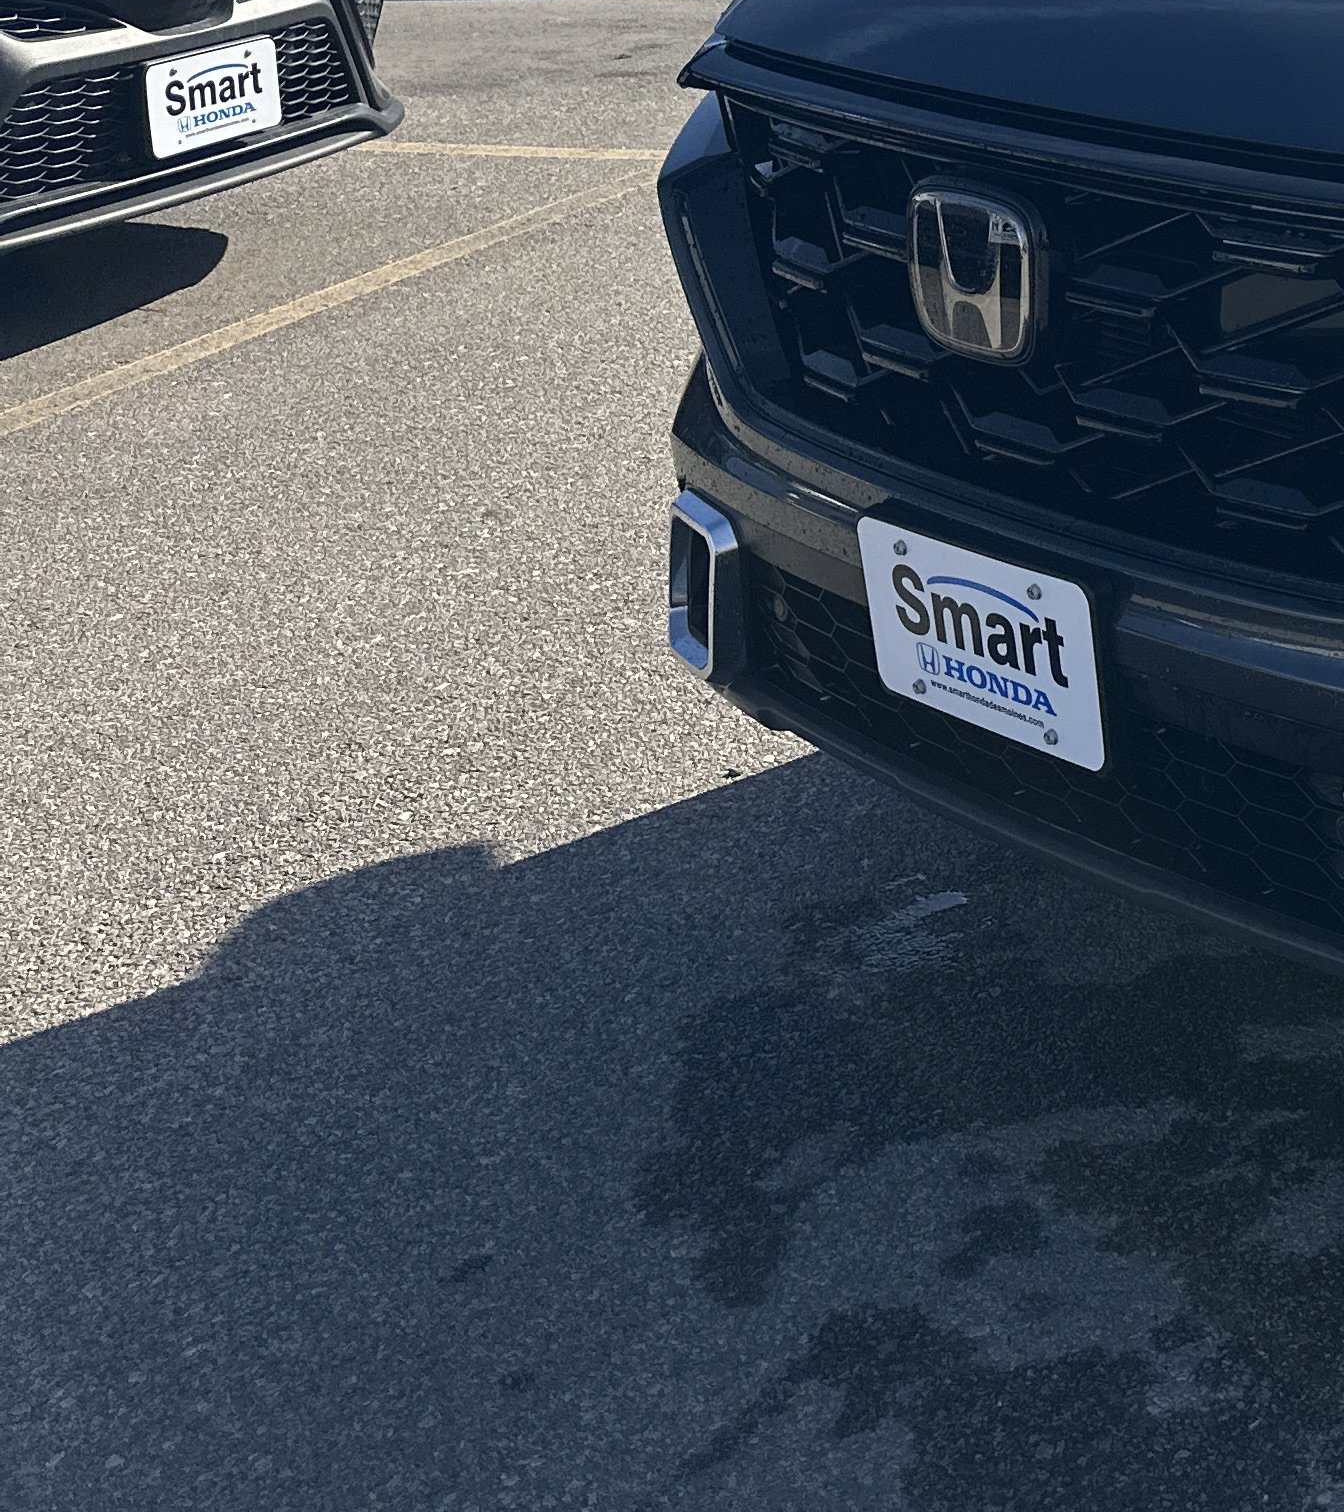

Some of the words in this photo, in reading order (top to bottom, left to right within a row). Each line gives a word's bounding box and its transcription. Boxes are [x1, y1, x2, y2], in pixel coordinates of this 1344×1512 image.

[165, 63, 263, 116] Smart
[193, 102, 256, 127] HONDA
[892, 564, 1069, 688] Smart
[942, 655, 1058, 717] HONDA
